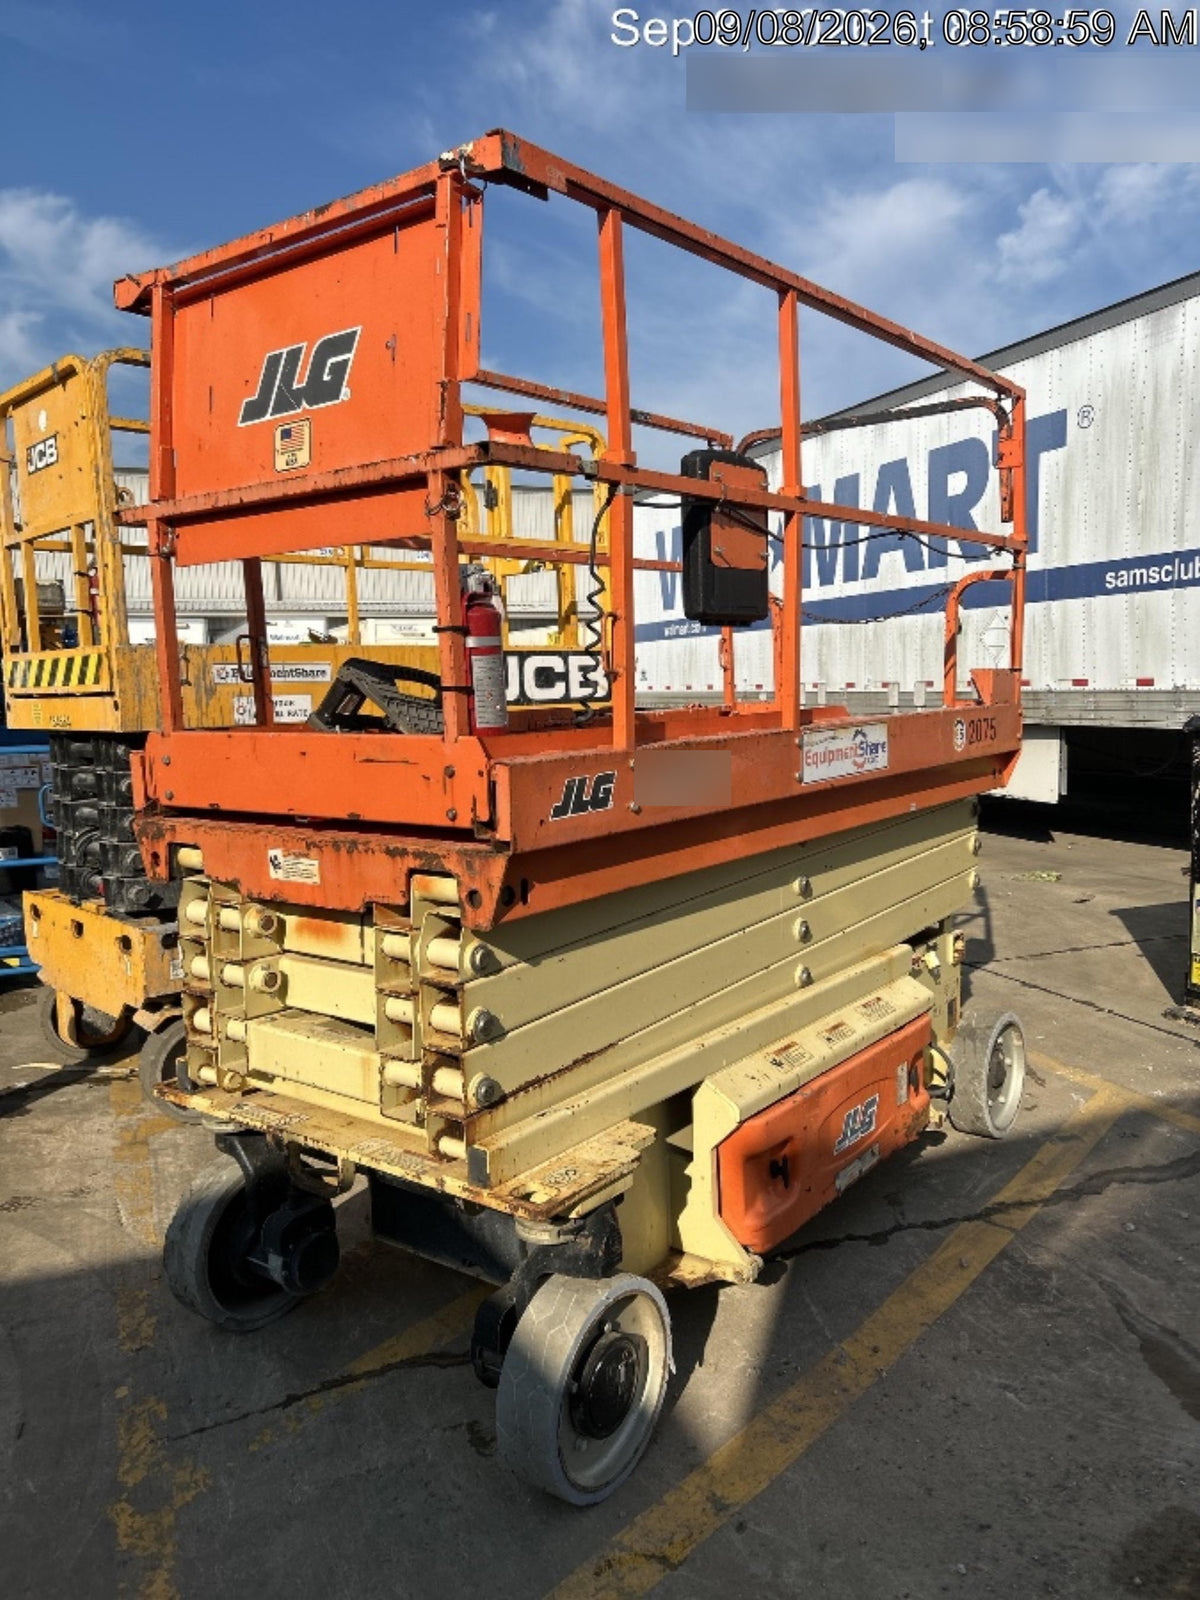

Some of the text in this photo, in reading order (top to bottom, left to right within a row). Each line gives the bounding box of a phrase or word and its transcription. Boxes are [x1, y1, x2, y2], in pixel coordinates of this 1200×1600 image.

[238, 325, 362, 427] JLG
[27, 435, 58, 473] JCB
[504, 655, 610, 702] JCB
[968, 717, 998, 746] 2075
[549, 770, 618, 822] JLG
[833, 1092, 880, 1157] JLG
